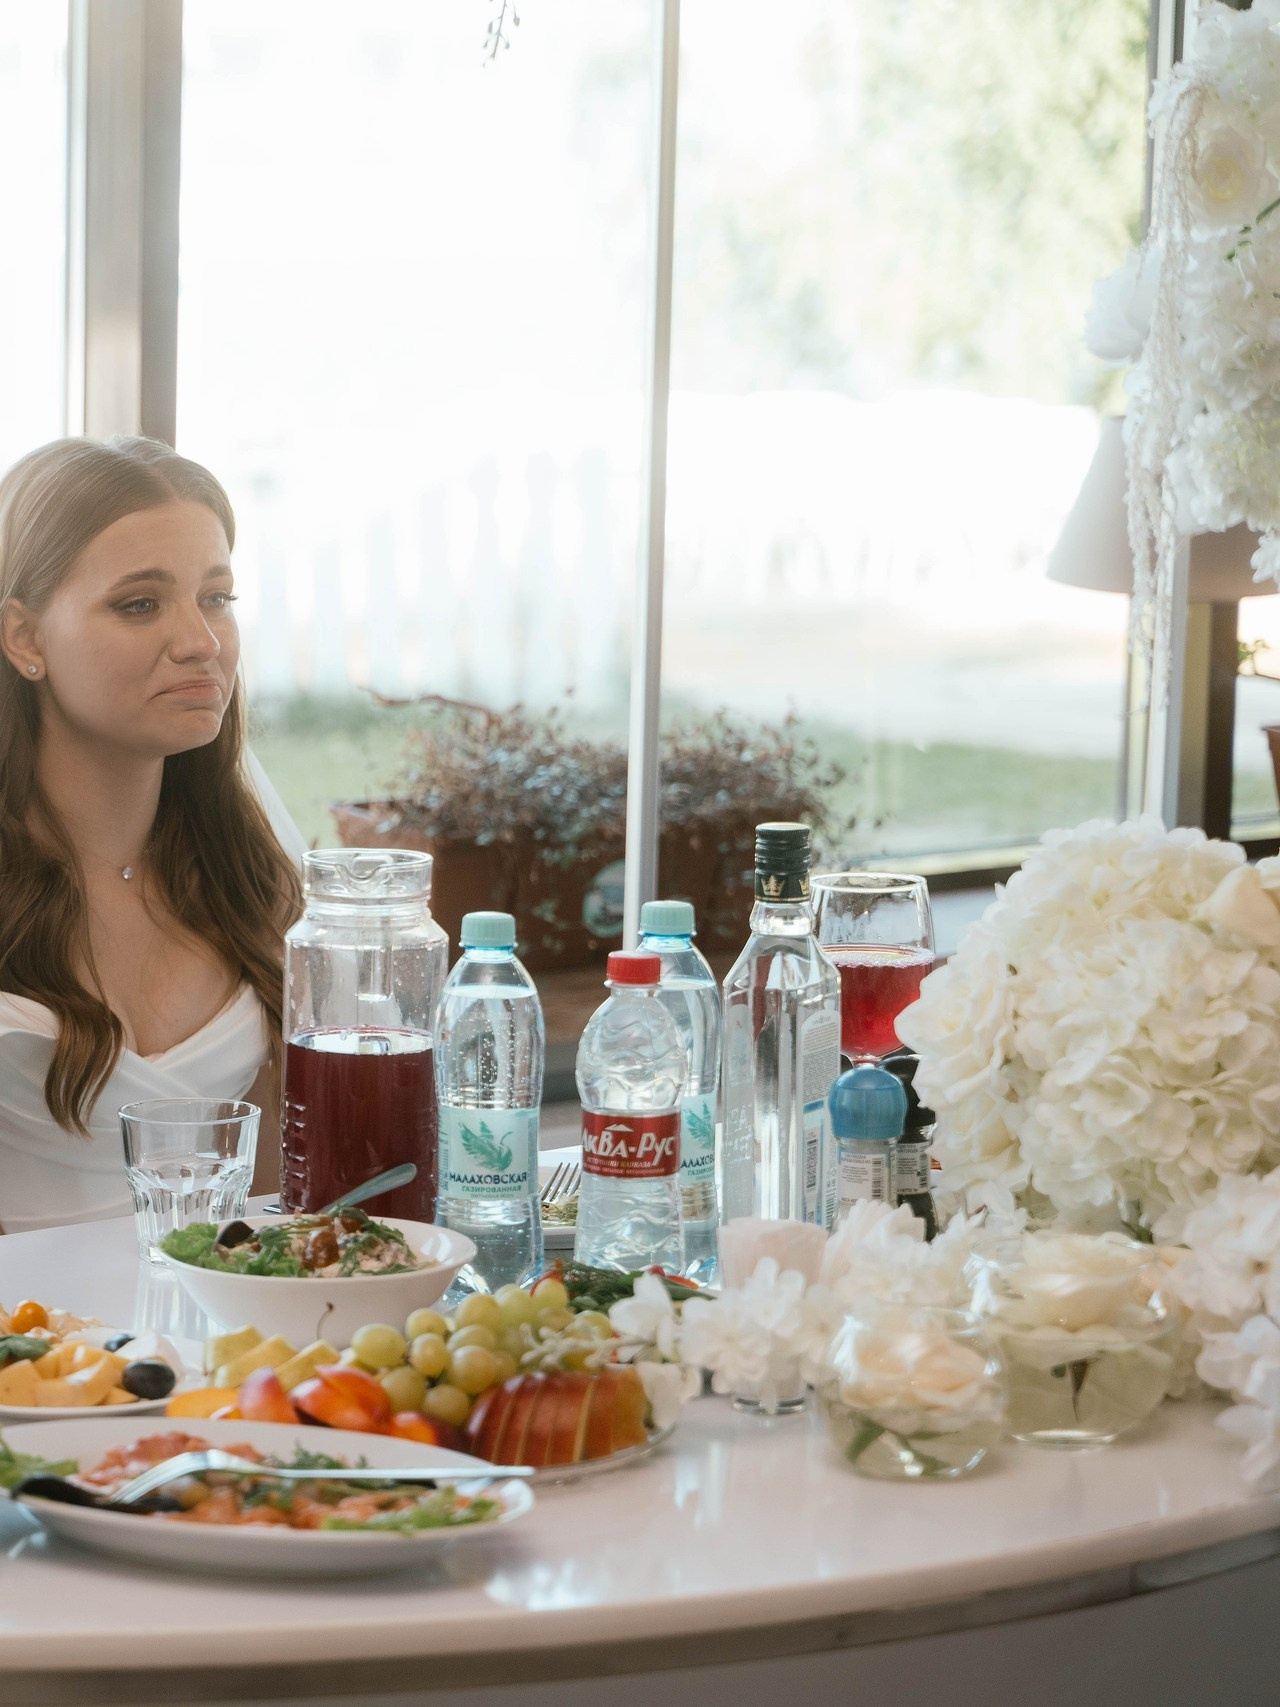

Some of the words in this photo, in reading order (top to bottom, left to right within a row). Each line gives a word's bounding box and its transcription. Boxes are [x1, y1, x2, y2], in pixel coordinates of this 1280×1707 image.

[680, 1154, 715, 1168] АЛАХОВ
[448, 1171, 528, 1185] МАЛАХОВСКАЯ
[461, 1185, 522, 1193] ГАЗИРОВАННАЯ
